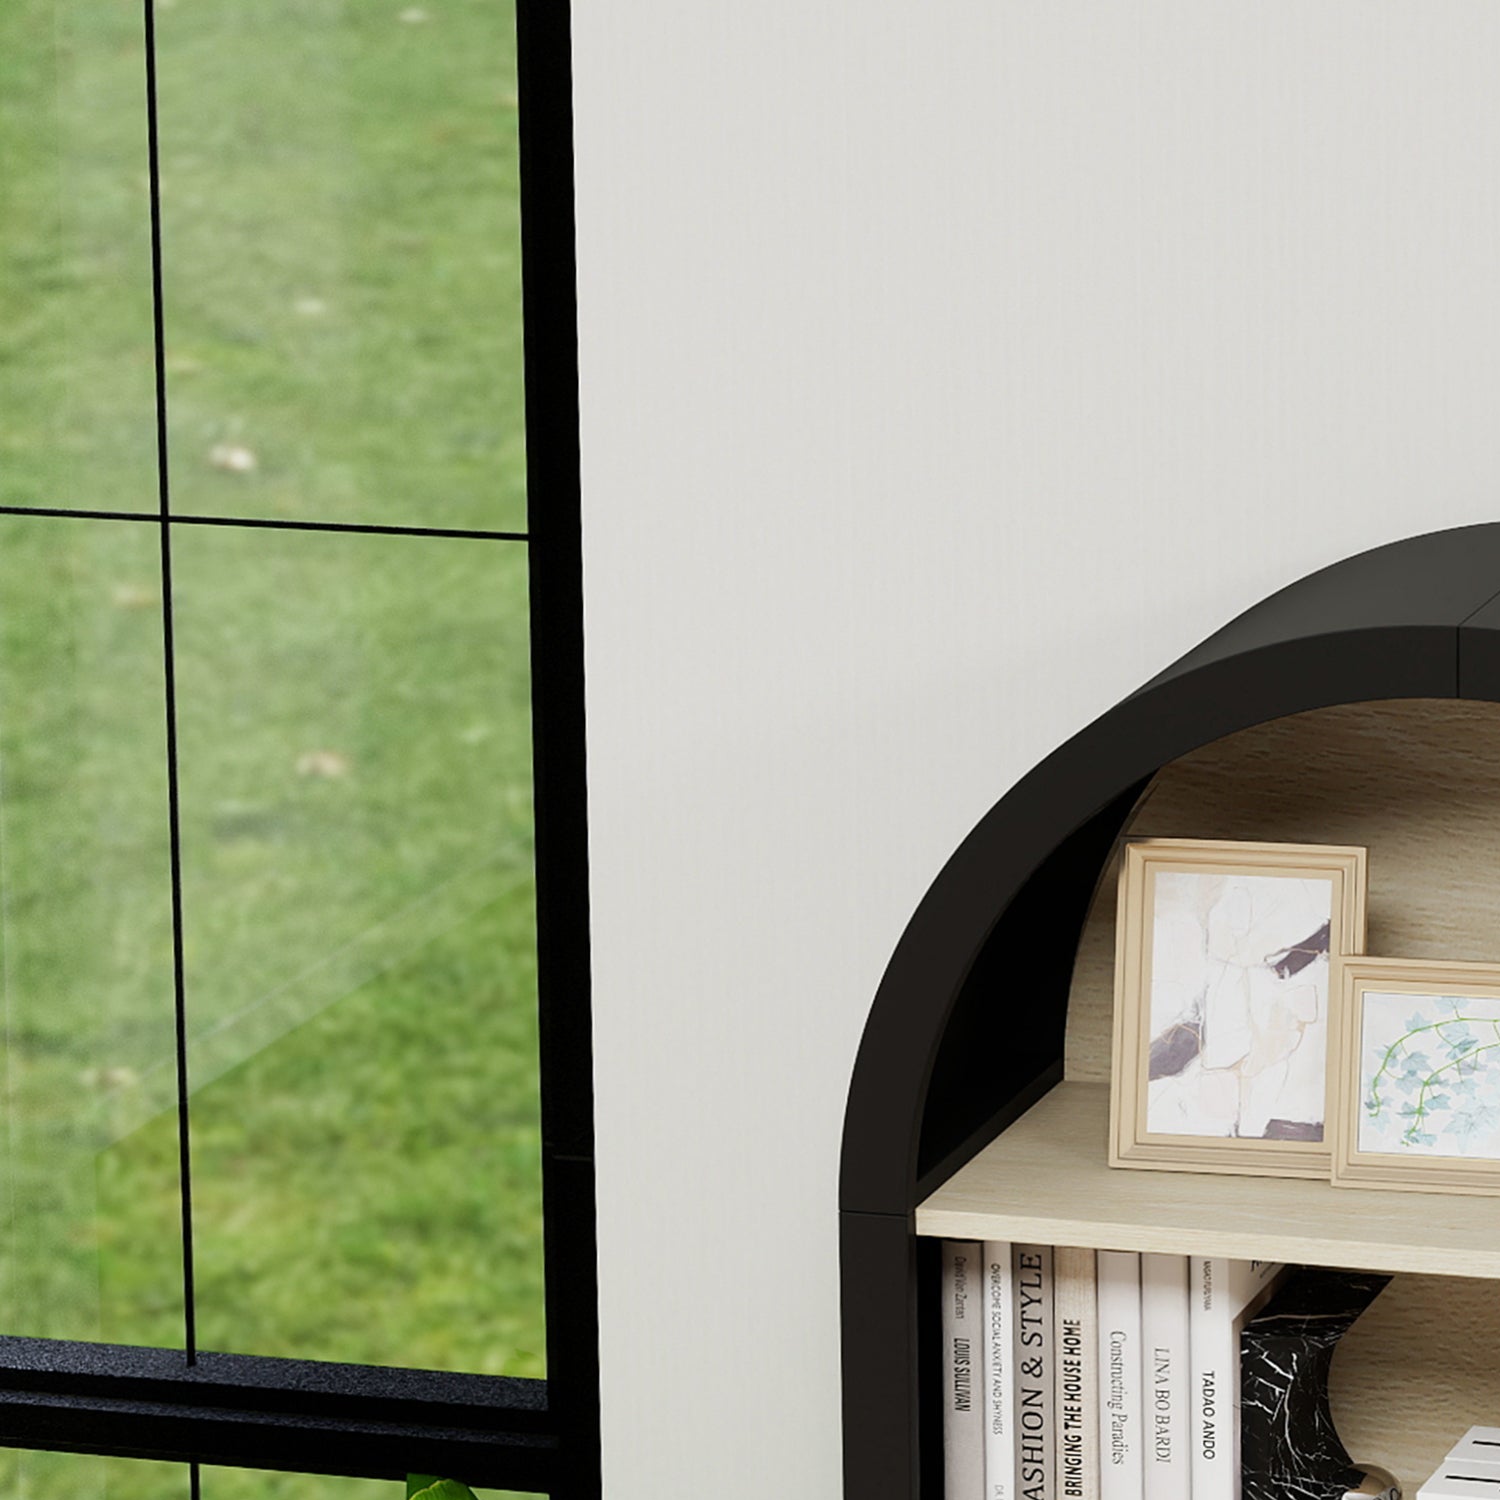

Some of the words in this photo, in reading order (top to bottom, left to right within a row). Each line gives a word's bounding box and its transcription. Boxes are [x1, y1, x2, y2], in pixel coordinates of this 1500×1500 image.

[991, 1263, 1001, 1309] OVERCOME
[1019, 1253, 1042, 1348] STYLE
[991, 1311, 1002, 1340] SOCIAL
[1063, 1319, 1081, 1356] HOME
[954, 1338, 971, 1365] LOUIS
[992, 1341, 1002, 1377] ANXIETY
[1021, 1354, 1043, 1379] &
[1107, 1330, 1127, 1410] Constructing
[1154, 1348, 1170, 1385] LINA
[954, 1367, 971, 1412] SULLIVAN
[992, 1379, 1003, 1398] AND
[1064, 1359, 1082, 1402] HOUSE
[1202, 1371, 1216, 1418] TADAO
[992, 1400, 1003, 1435] SHYNESS
[1064, 1405, 1082, 1430] THE
[1155, 1390, 1170, 1411] BO
[1155, 1415, 1171, 1464] BARDI
[1202, 1420, 1216, 1460] ANDO
[1064, 1434, 1082, 1497] BRINGING
